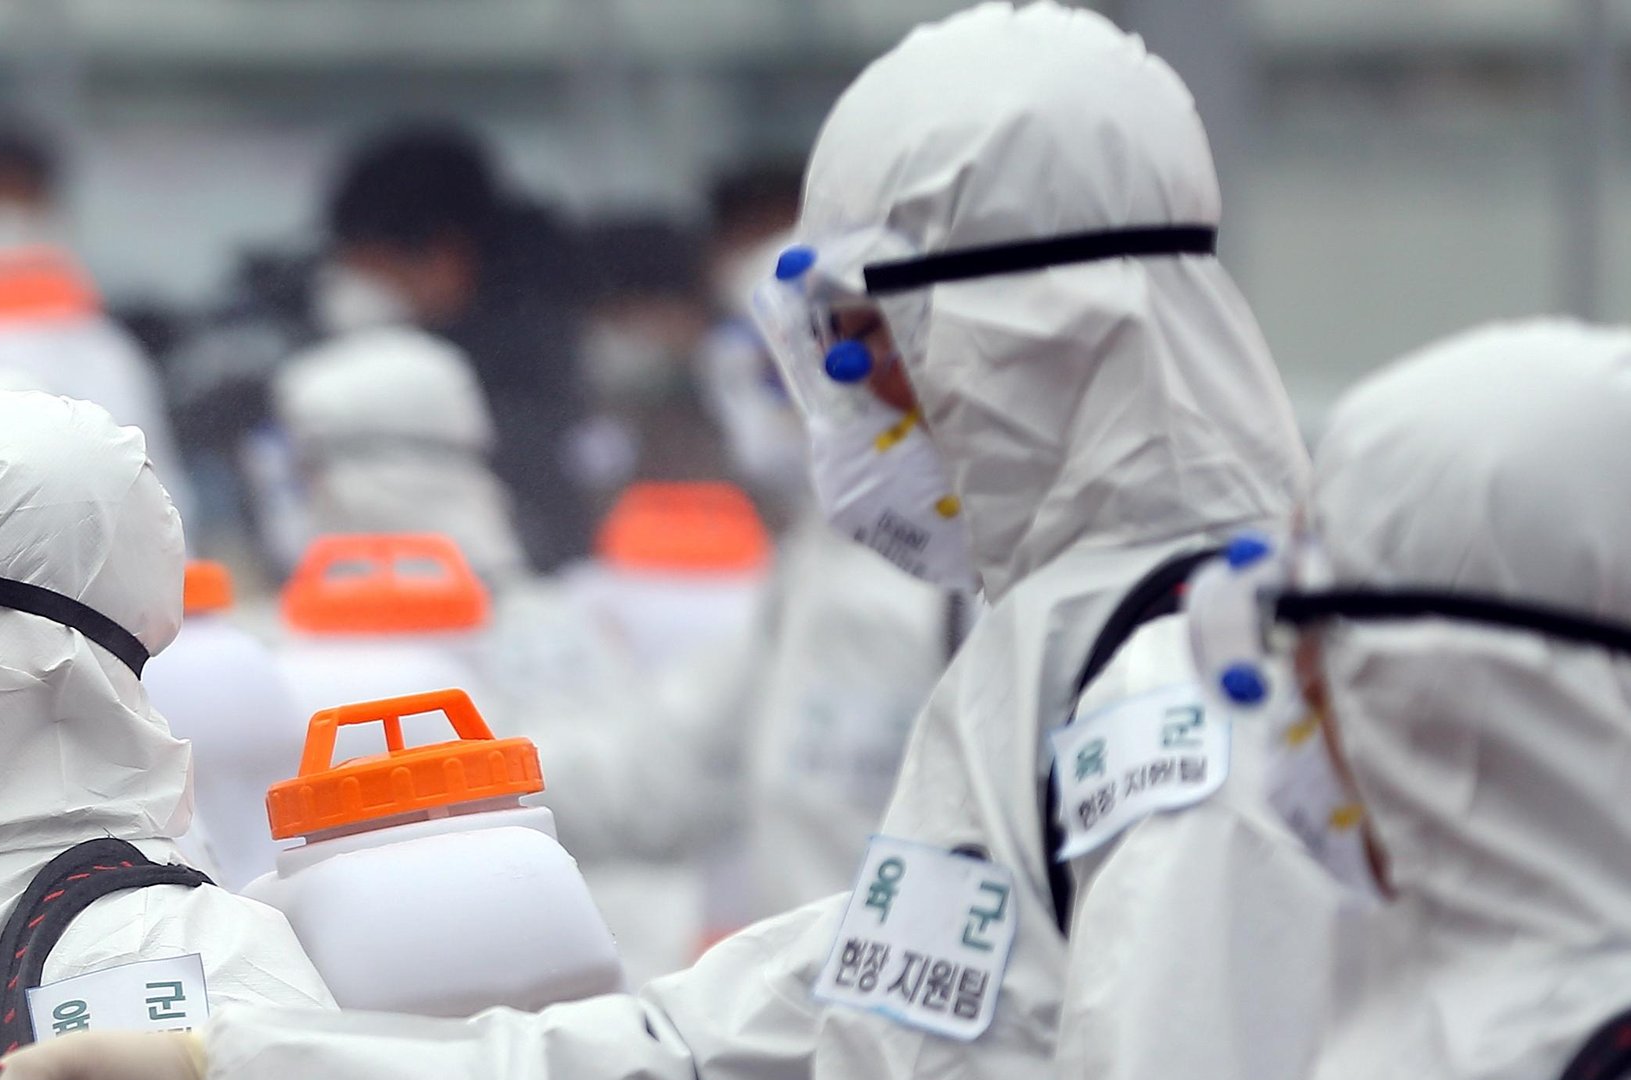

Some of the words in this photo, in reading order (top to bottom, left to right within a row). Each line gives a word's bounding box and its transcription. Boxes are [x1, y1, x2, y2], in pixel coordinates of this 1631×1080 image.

[1162, 703, 1205, 749] 군
[865, 856, 906, 925] 육
[962, 880, 1012, 951] 군
[145, 981, 187, 1021] 군
